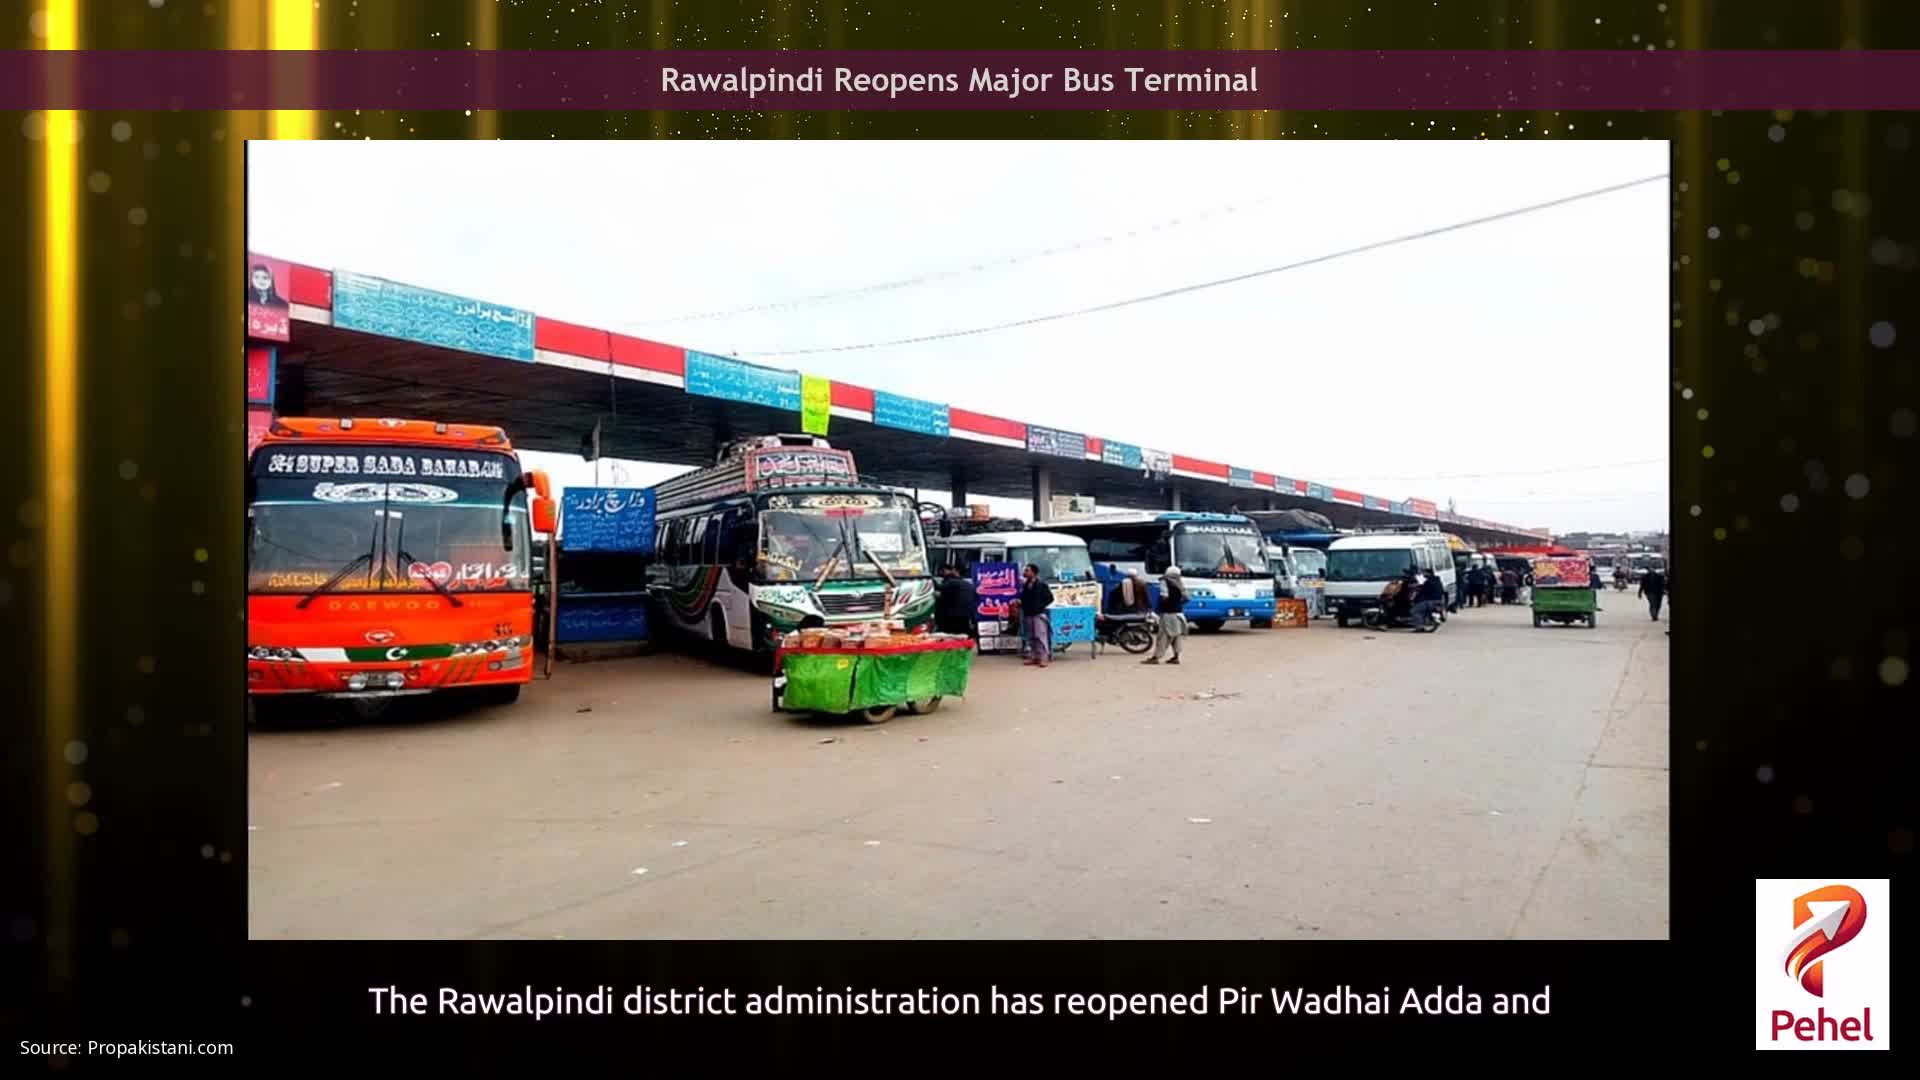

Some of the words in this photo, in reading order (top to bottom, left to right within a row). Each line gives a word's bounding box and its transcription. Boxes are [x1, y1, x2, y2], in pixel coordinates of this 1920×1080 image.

[295, 454, 359, 474] SUPER
[419, 458, 482, 478] BAHAR
[328, 600, 440, 611] DAEWOO
